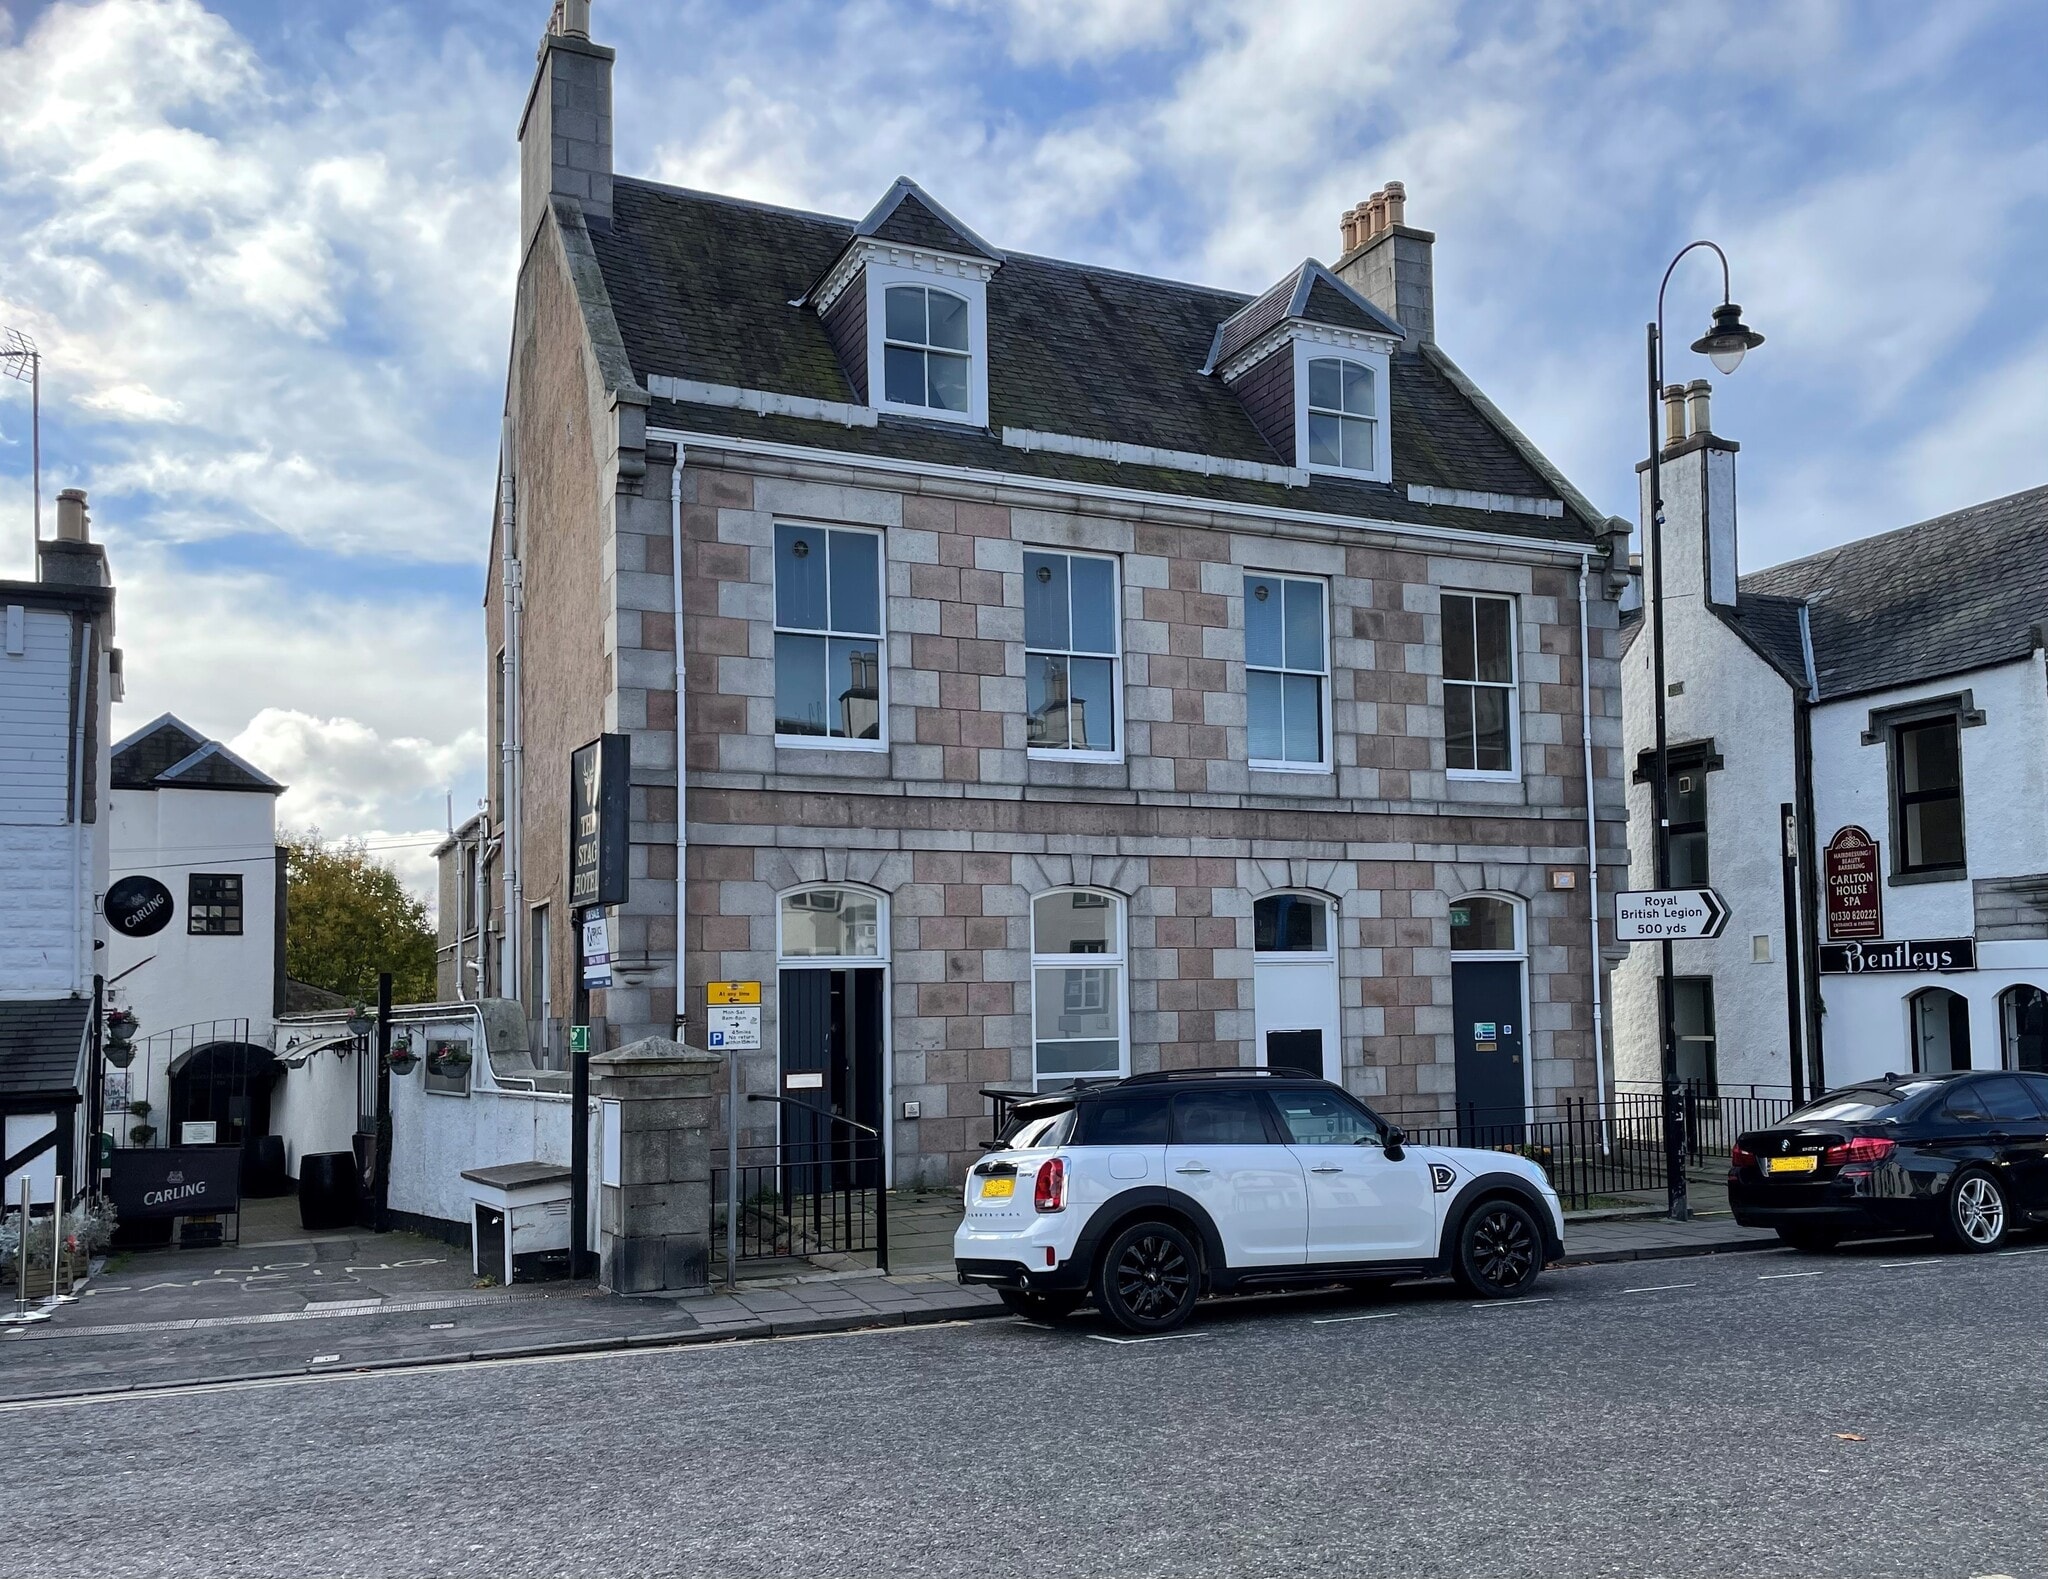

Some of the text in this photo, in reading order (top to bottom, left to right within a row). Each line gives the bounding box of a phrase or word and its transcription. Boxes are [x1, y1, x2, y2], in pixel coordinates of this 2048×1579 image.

[578, 841, 597, 866] STAG
[1838, 862, 1866, 871] BARBERING
[1842, 857, 1861, 865] BEAUTY
[574, 870, 598, 896] HOTEL
[1830, 871, 1874, 886] CARLTON
[1836, 884, 1868, 896] HOUSE
[1644, 895, 1678, 907] Royal
[1843, 896, 1861, 907] SPA
[124, 892, 165, 929] CARLING
[1621, 907, 1703, 919] British Legion
[1830, 908, 1877, 921] 01330 820222
[1637, 923, 1687, 935] 500 yds
[1841, 941, 1953, 974] Bentleys
[713, 1033, 722, 1044] P
[143, 1180, 207, 1206] CARLING
[213, 1260, 311, 1276] NO
[84, 1256, 447, 1297] PARKING
